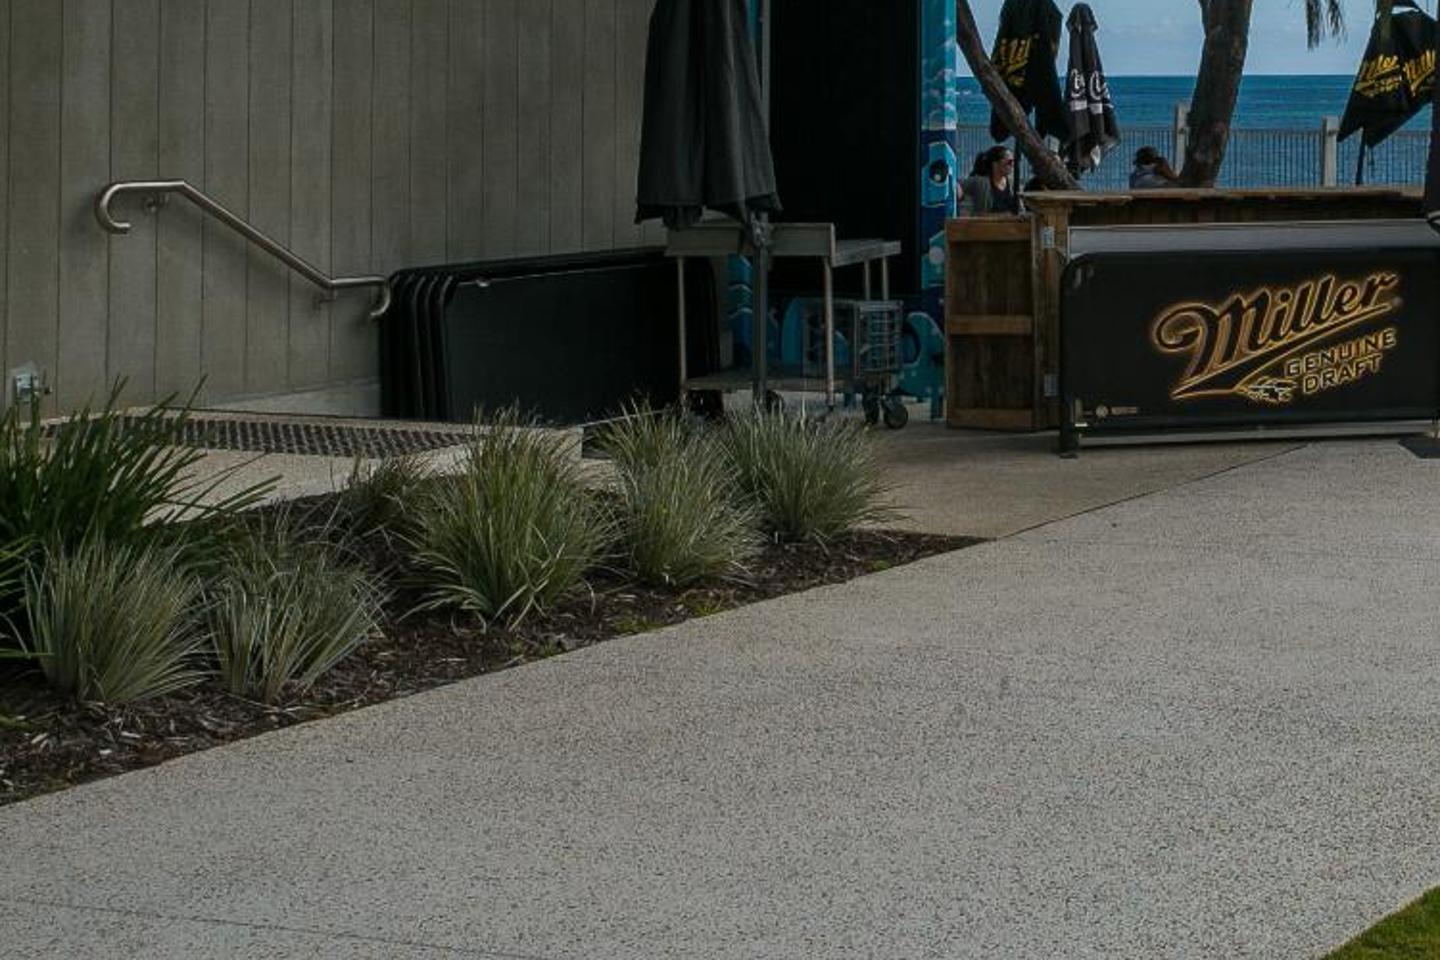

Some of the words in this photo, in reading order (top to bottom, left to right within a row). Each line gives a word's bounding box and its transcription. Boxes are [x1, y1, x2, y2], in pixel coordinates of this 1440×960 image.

[1152, 270, 1399, 388] Miller
[1285, 327, 1398, 377] GENUINE
[1302, 353, 1383, 395] DRAFT
